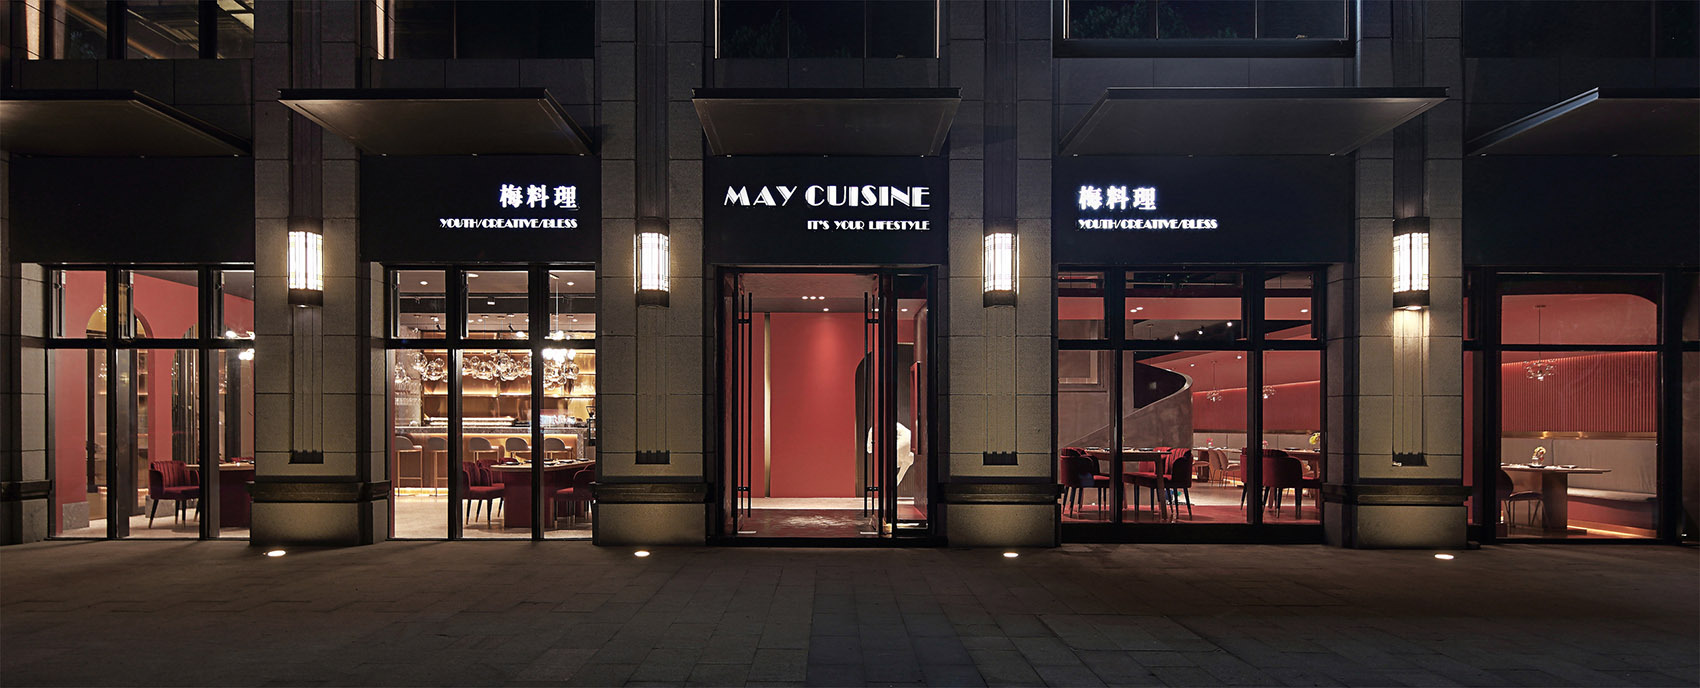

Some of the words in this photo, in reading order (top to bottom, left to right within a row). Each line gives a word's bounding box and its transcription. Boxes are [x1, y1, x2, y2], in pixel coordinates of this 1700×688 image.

[499, 184, 578, 209] 梅料理
[724, 185, 797, 206] MAY
[804, 185, 931, 207] CUISINE
[1078, 185, 1157, 210] 梅料理
[440, 218, 578, 228] YOUTH/CREATIVE/BLESS
[807, 220, 830, 230] IT'S
[834, 220, 864, 230] YOUR
[868, 220, 930, 230] LIFESTYLE
[1078, 218, 1218, 229] YOUTH/CREATIVE/BLESS
